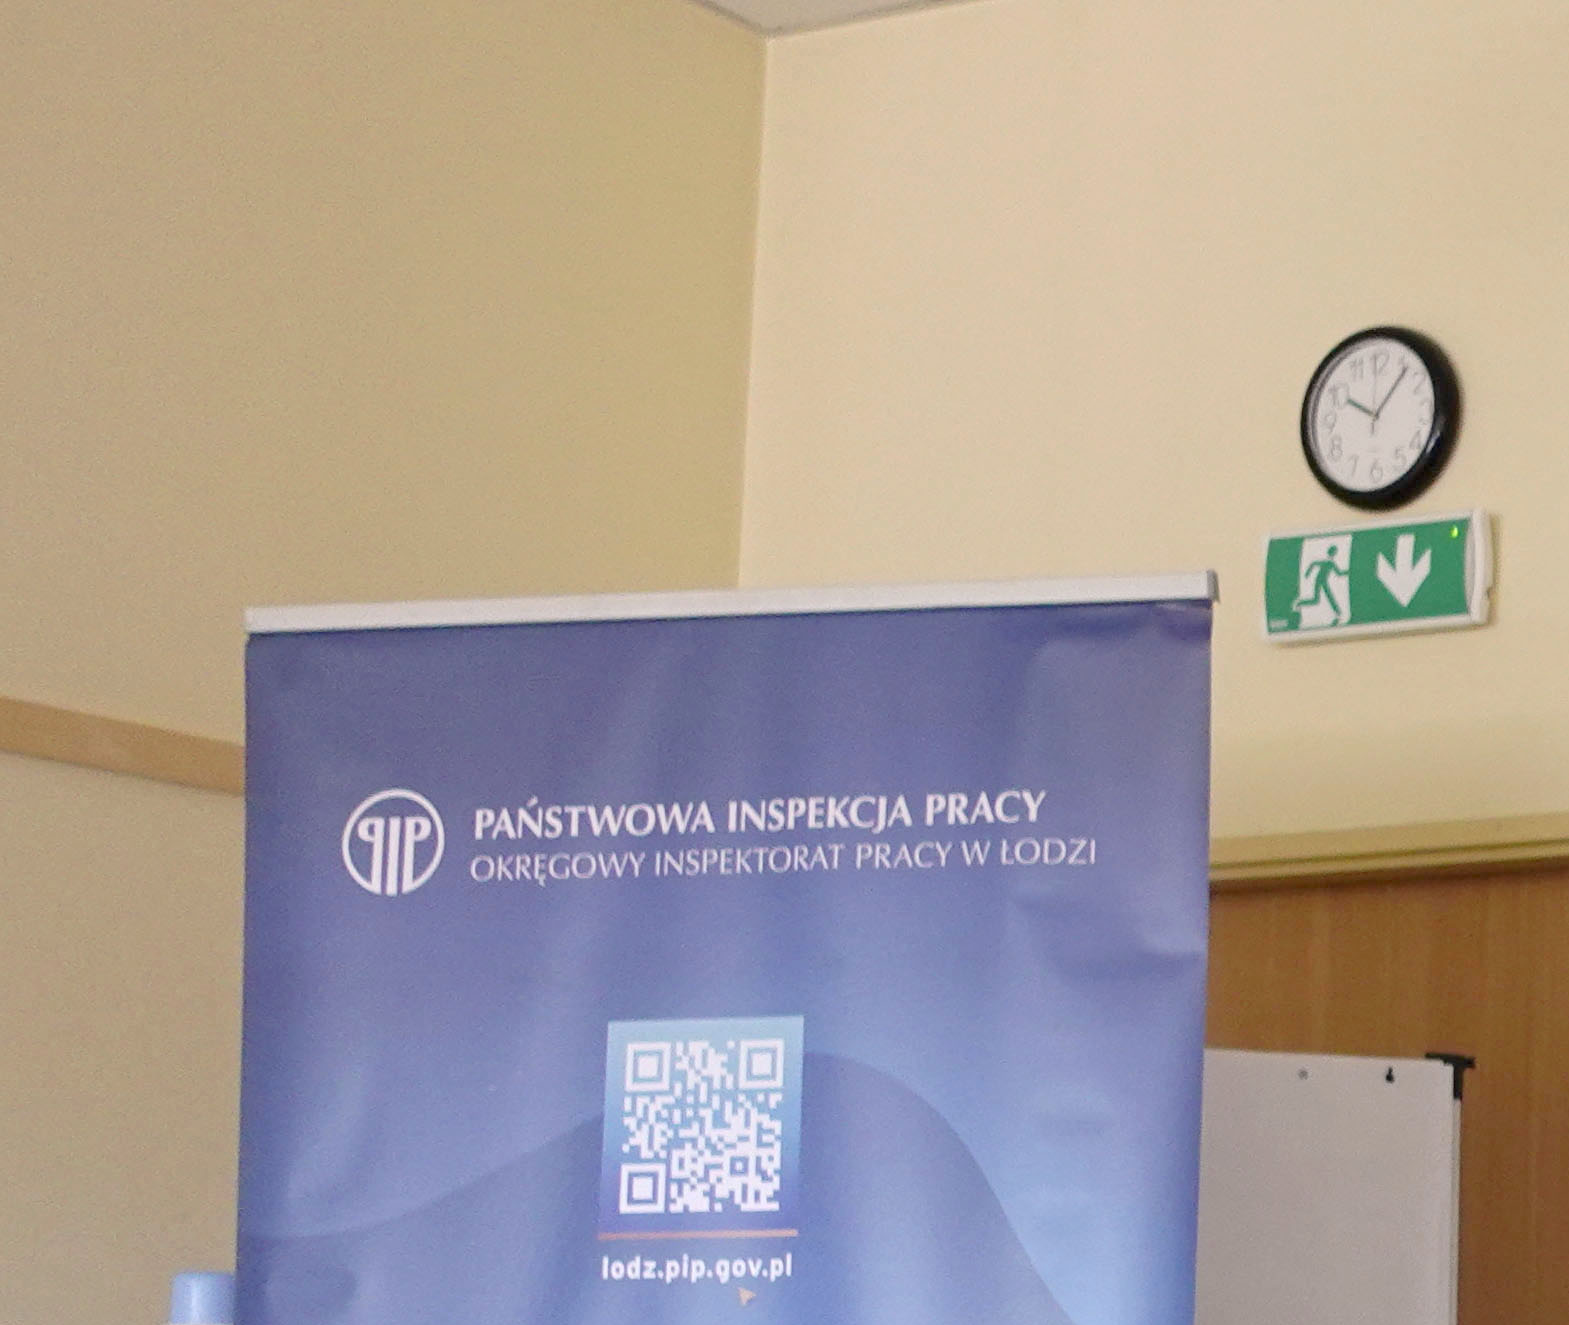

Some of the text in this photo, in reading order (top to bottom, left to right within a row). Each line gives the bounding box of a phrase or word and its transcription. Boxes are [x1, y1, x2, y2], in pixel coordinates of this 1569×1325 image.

[473, 789, 1046, 839] PAŃSTWOWA INSPEKCJA PRACY
[470, 836, 1097, 887] OKRĘGOWY INSPEKTORAT PRACY W ŁODZI
[602, 1252, 793, 1284] lodz.pip.gov.pl
